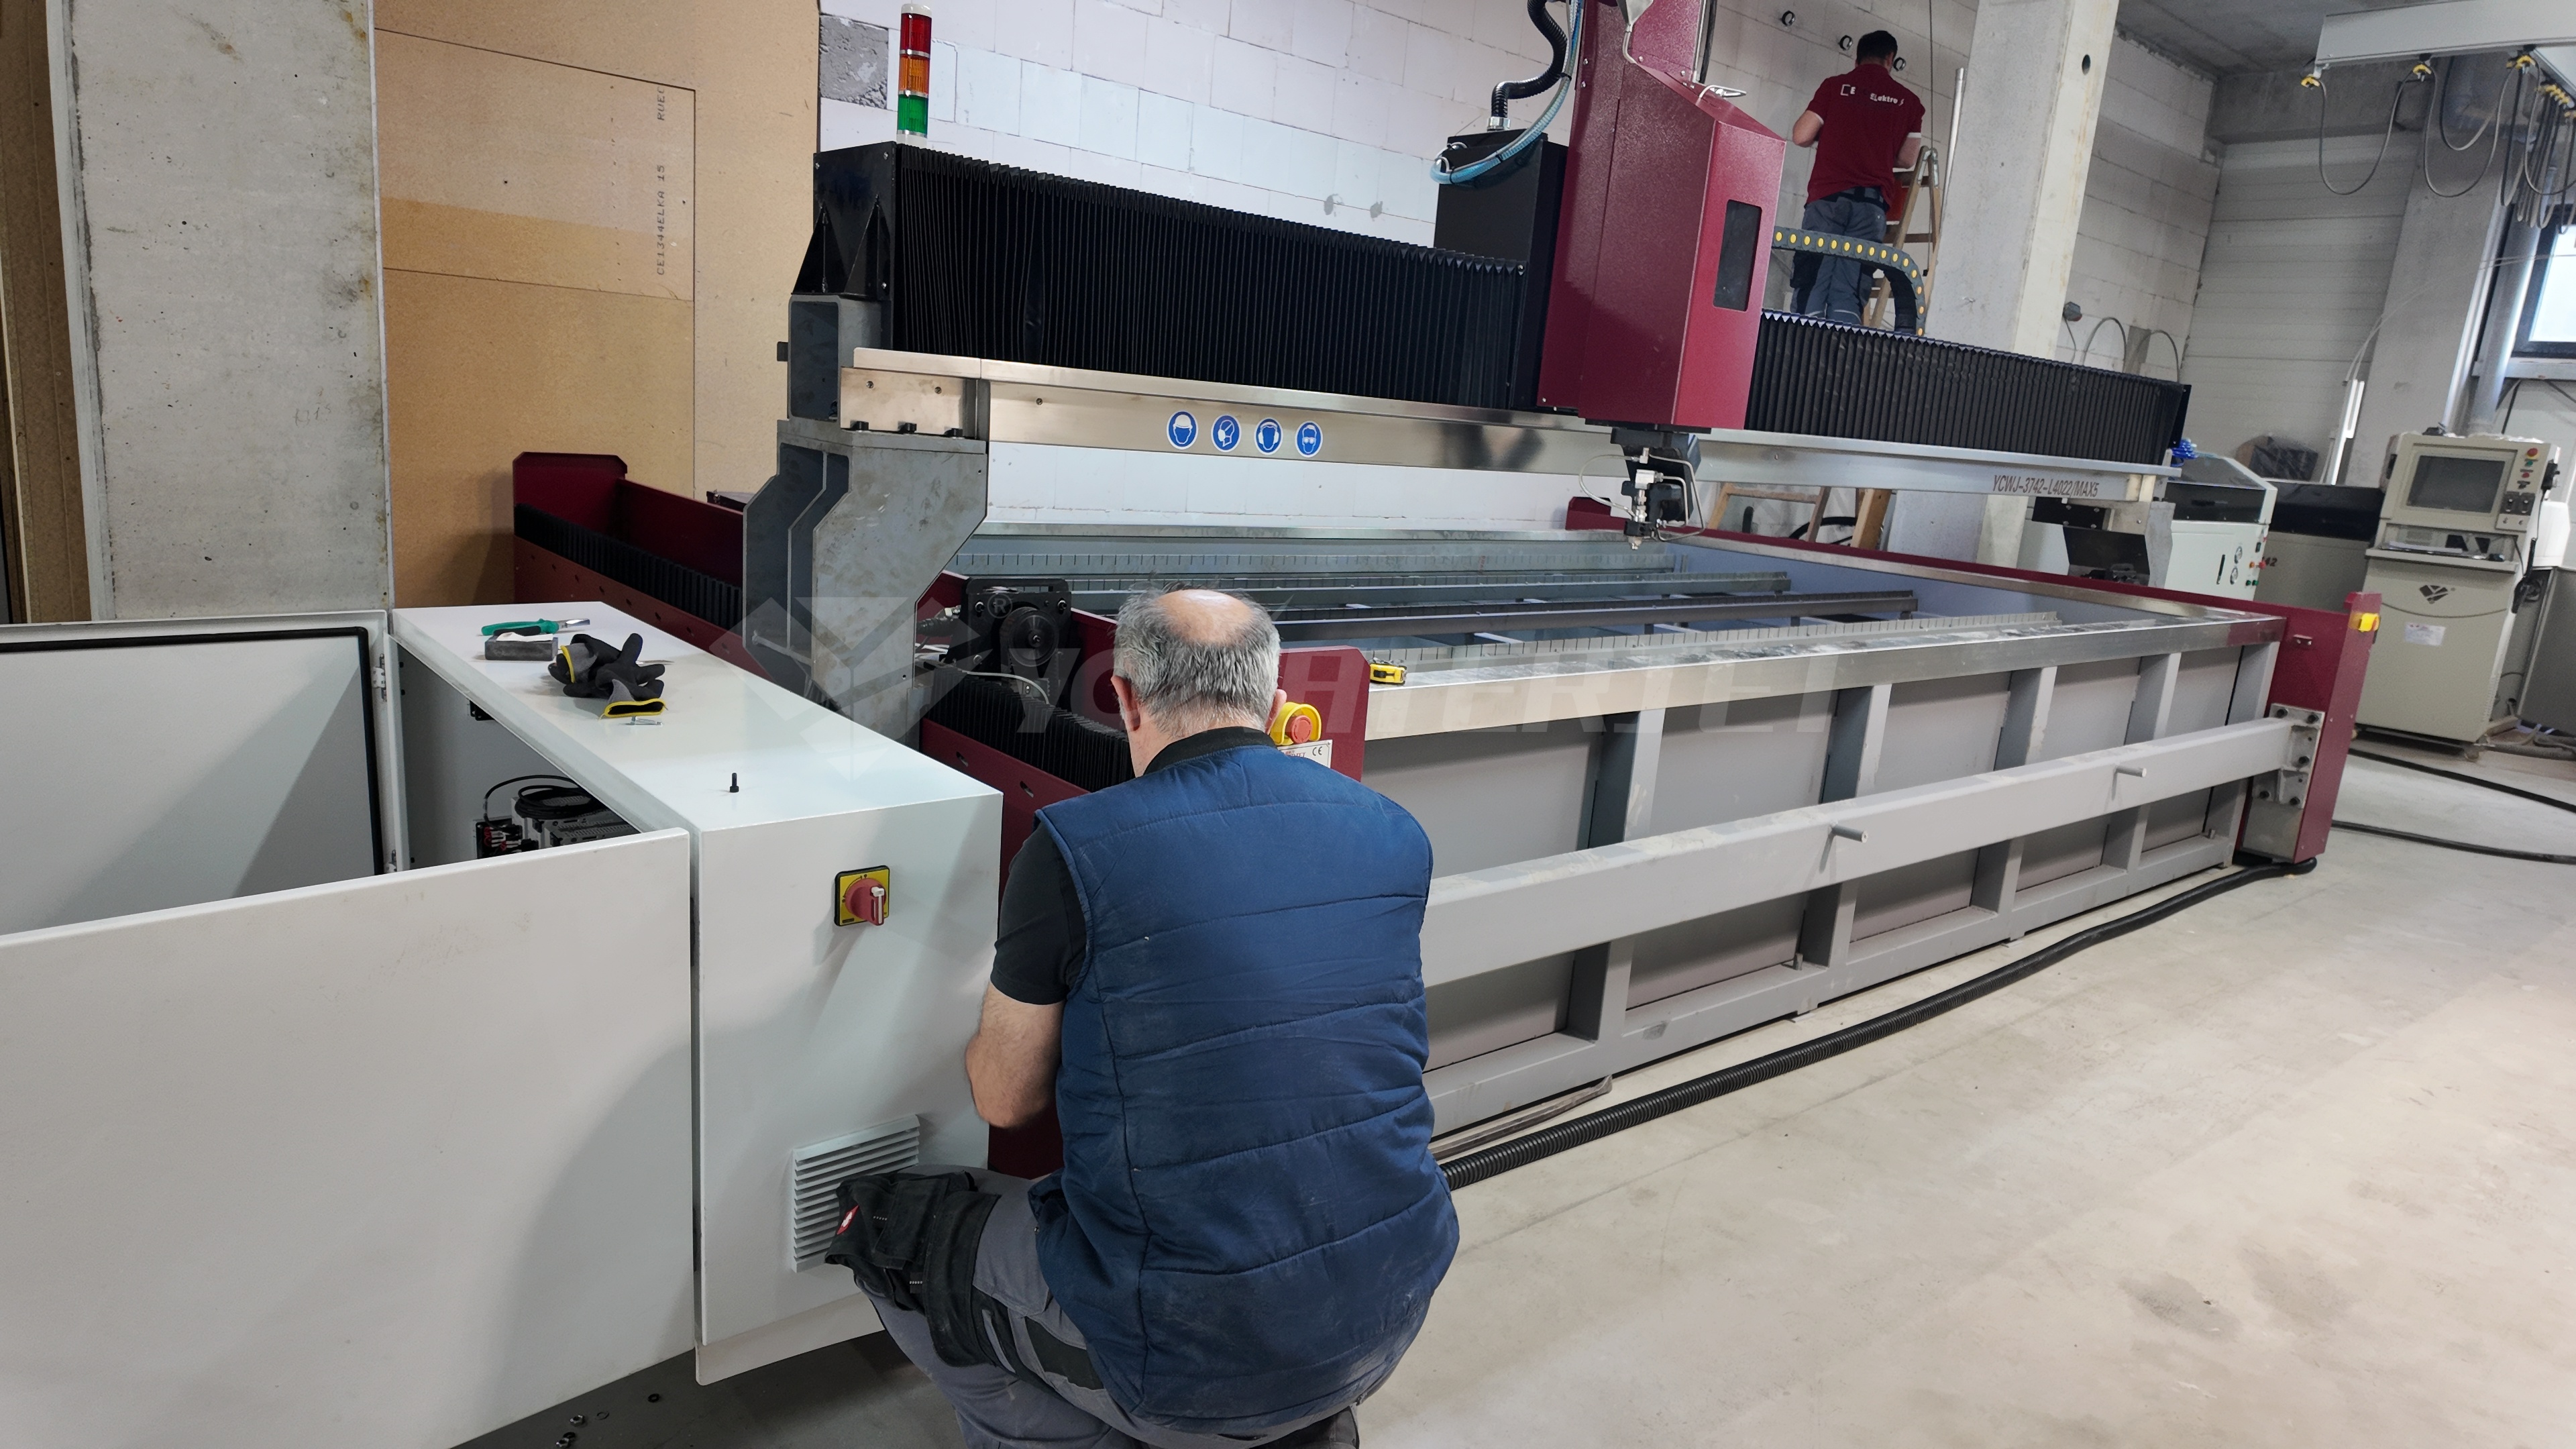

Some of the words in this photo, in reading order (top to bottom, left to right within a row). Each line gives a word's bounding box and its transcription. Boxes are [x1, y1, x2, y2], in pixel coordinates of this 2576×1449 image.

[657, 165, 665, 182] 15
[657, 191, 665, 276] CE1344ELKA
[1992, 474, 2099, 498] YCWJ-3742-L4022/MAX5
